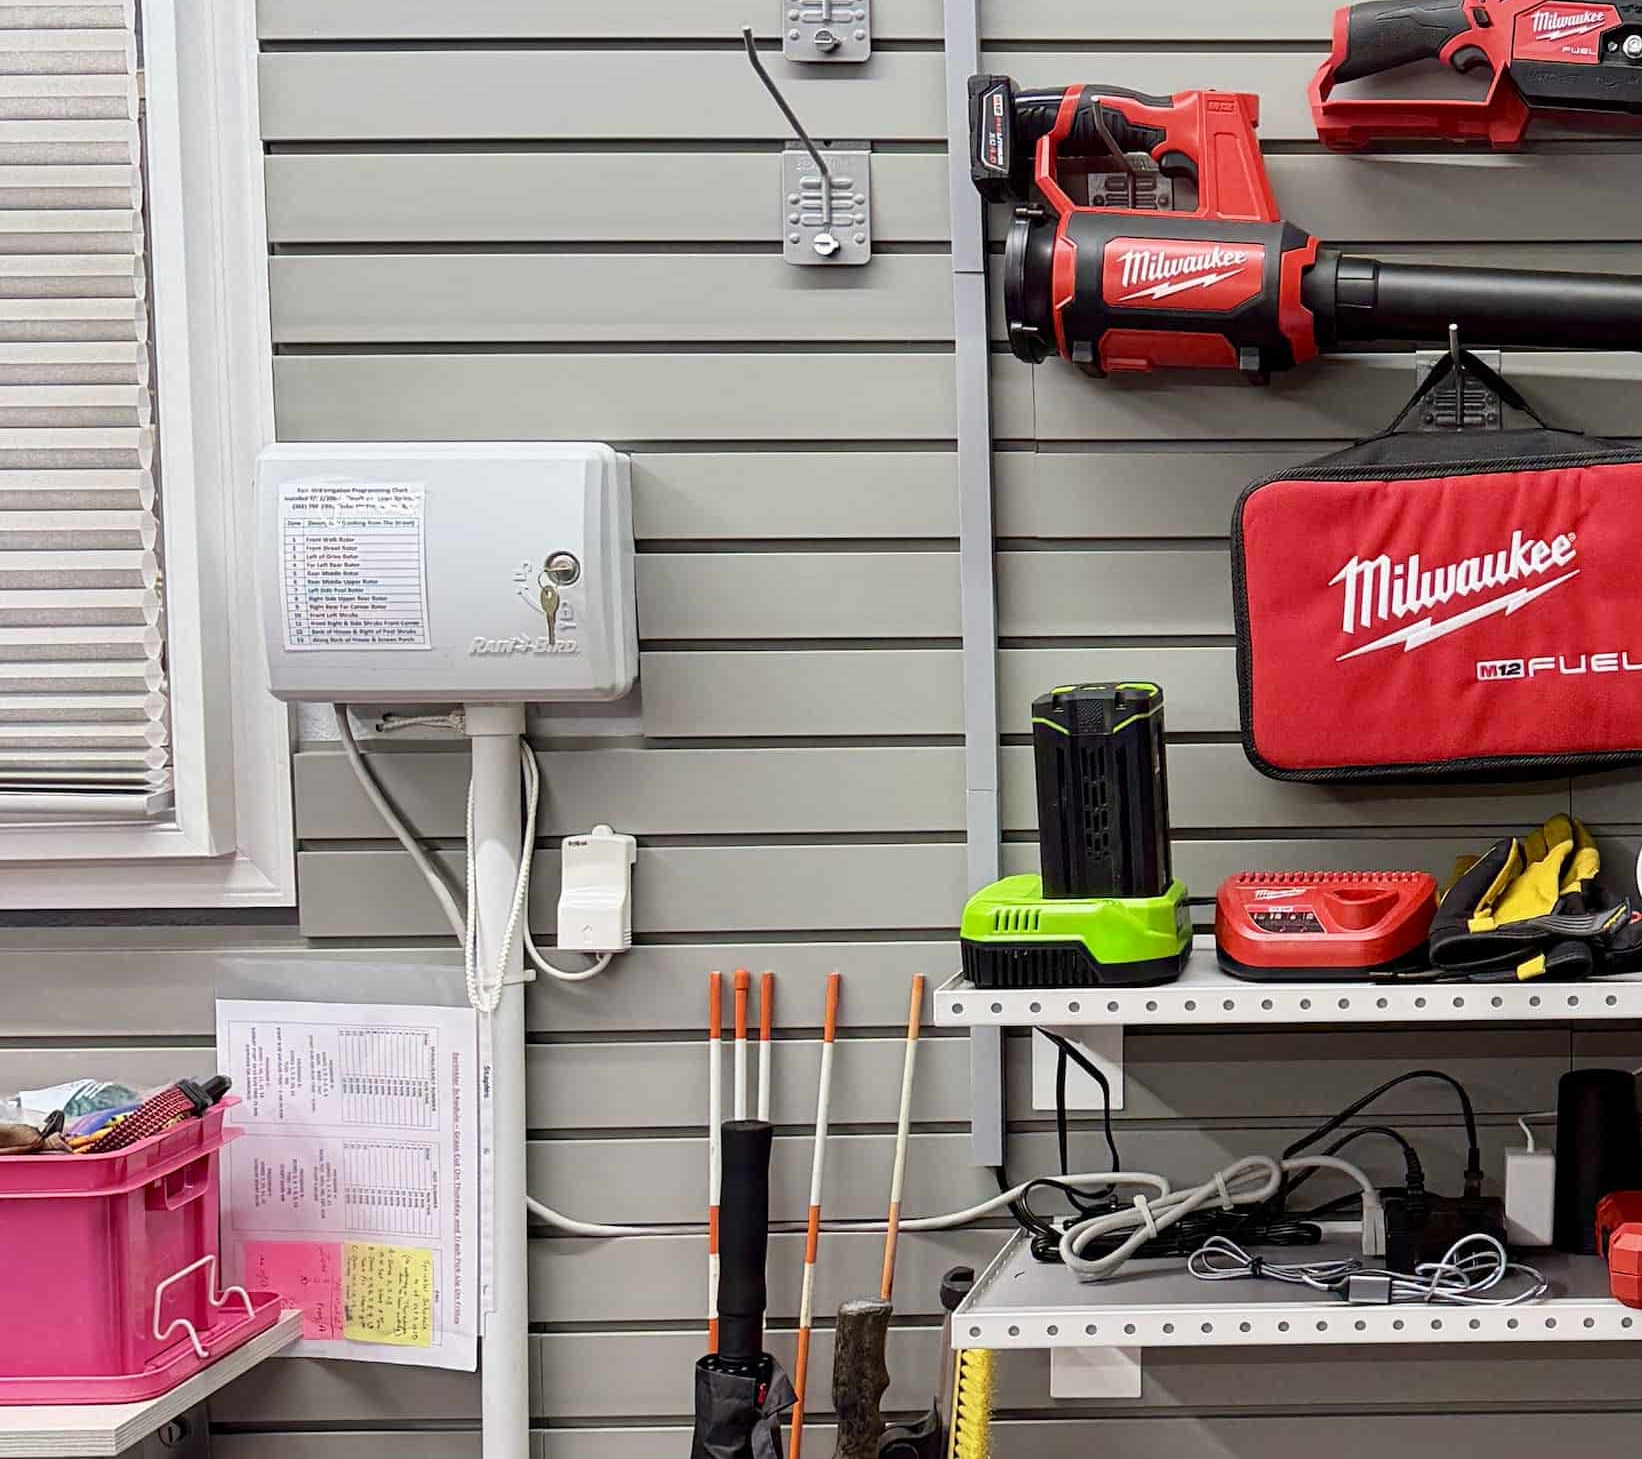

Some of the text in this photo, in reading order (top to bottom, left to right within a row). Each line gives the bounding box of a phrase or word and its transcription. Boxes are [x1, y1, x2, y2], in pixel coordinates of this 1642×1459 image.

[1530, 11, 1605, 33] Milwaukee
[1562, 46, 1597, 55] FUEL
[1116, 247, 1248, 288] Milwaukee
[1327, 530, 1578, 635] Milwaukee
[1479, 661, 1524, 678] M12
